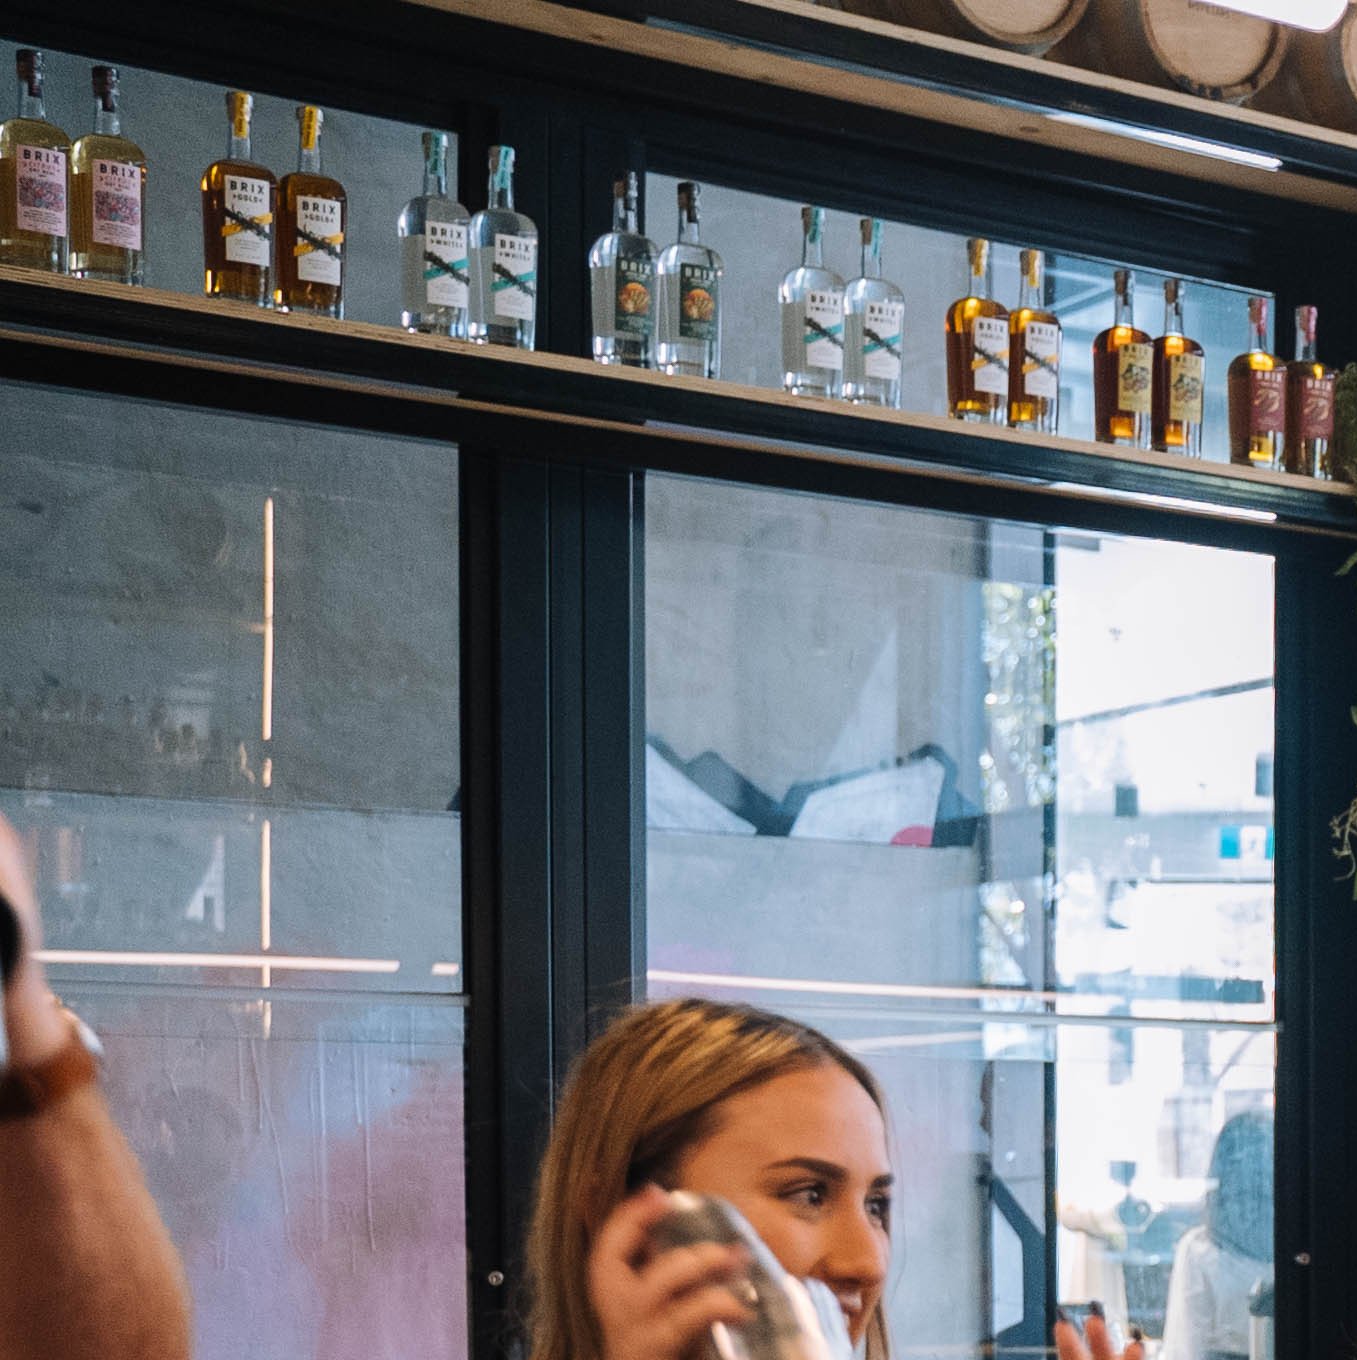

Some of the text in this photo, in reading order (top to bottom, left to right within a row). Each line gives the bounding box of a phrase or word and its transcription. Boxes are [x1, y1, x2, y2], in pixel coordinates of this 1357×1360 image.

[23, 149, 60, 164] BRIX
[100, 163, 136, 178] BRIX
[230, 180, 265, 195] BRIX
[301, 200, 336, 215] BRIX
[430, 225, 463, 240] BRIX
[500, 239, 531, 252] BRIX
